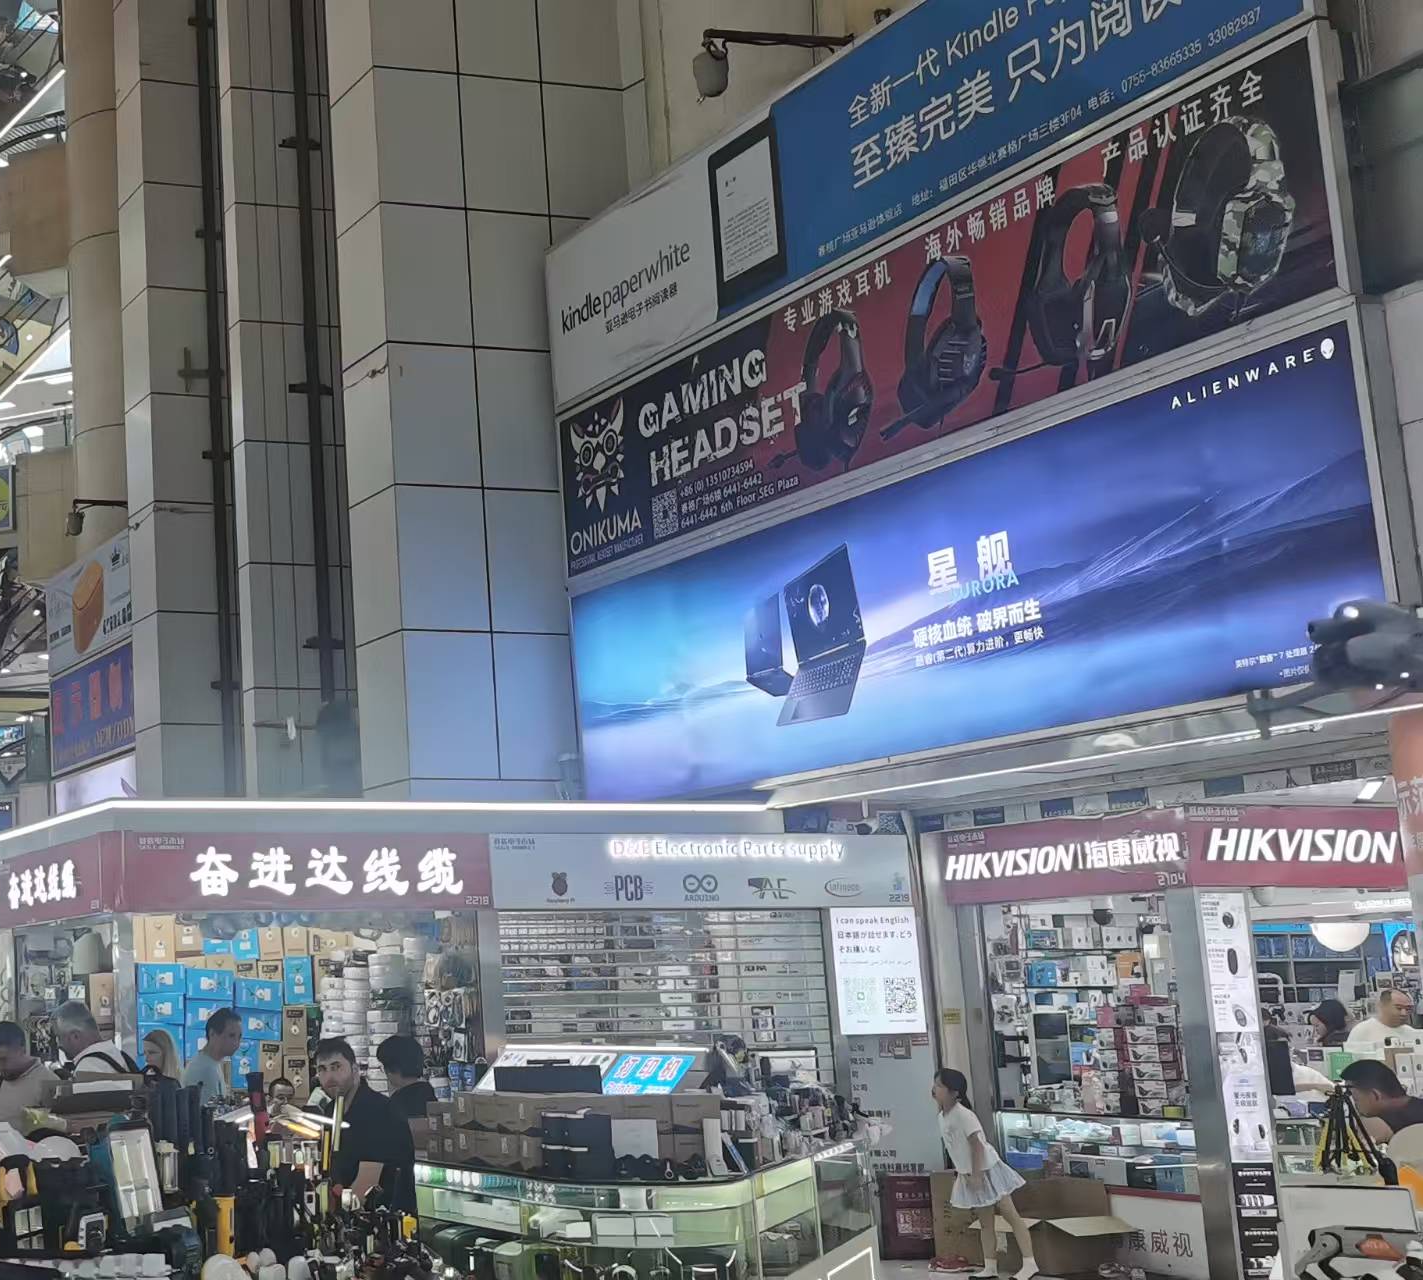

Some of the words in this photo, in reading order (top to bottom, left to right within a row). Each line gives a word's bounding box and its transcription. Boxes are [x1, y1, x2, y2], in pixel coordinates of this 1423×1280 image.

[1206, 8, 1262, 48] 33082937
[847, 47, 941, 129] 全新一代
[945, 6, 1019, 66] Kindle
[851, 69, 995, 190] 至臻完美
[1101, 70, 1264, 177] 产品认证齐全
[924, 172, 1056, 264] 海外畅销品牌
[783, 261, 892, 332] 专业游戏耳机
[638, 349, 767, 438] GAMING
[1171, 347, 1317, 409] ALIENWARE
[649, 381, 808, 487] HEADSET
[680, 507, 718, 529] 6441-6442
[721, 499, 734, 514] 6th
[737, 492, 757, 508] Floor
[777, 476, 799, 492] Plaza
[570, 506, 642, 555] ONIKUMA
[928, 531, 1013, 595] 星舰
[913, 616, 973, 648] 硬核血统
[976, 598, 1041, 633] 破界而生
[190, 845, 463, 897] 奋进达线缆
[655, 839, 739, 858] Electronic
[743, 840, 785, 858] Parts
[789, 840, 845, 861] supply
[945, 843, 1076, 881] HIKVISION
[1085, 832, 1180, 869] 海康威视
[1207, 828, 1398, 864] HIKVISION
[614, 875, 644, 901] PCB
[855, 917, 878, 925] speak
[880, 916, 909, 925] English
[1122, 1230, 1193, 1258] 康威视
